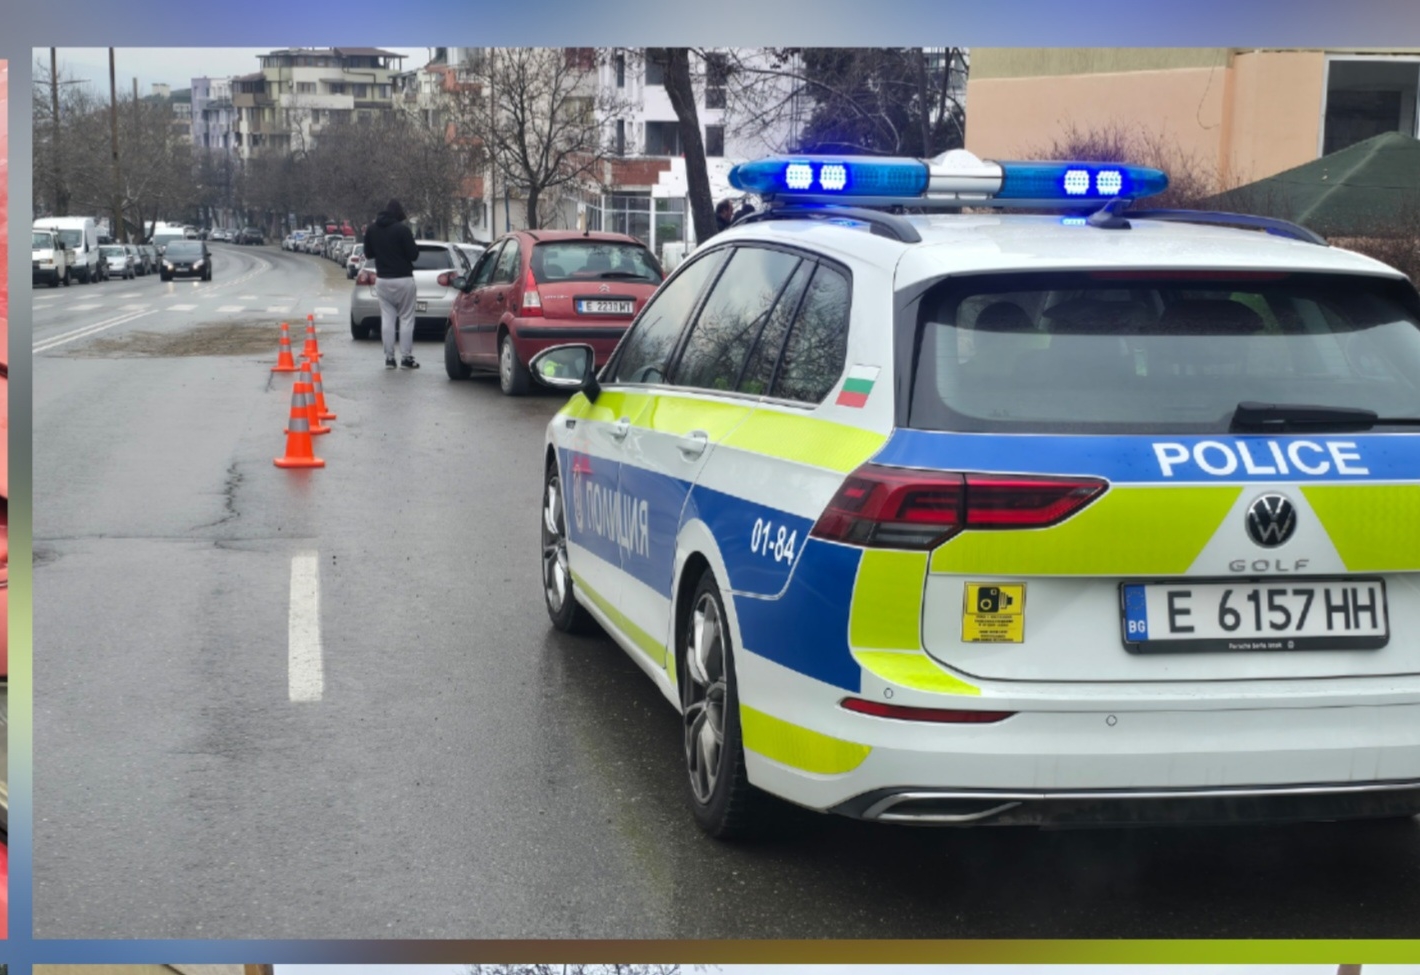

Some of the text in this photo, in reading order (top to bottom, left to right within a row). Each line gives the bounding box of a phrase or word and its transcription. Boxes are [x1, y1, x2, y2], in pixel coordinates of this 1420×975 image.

[1151, 440, 1370, 477] POLICE
[586, 481, 649, 558] ПОЛИЦИЯ
[751, 518, 797, 565] 01-84
[1229, 559, 1310, 572] GOLF
[1128, 620, 1146, 634] BG
[1167, 590, 1195, 633] E
[1218, 588, 1315, 632] 6157
